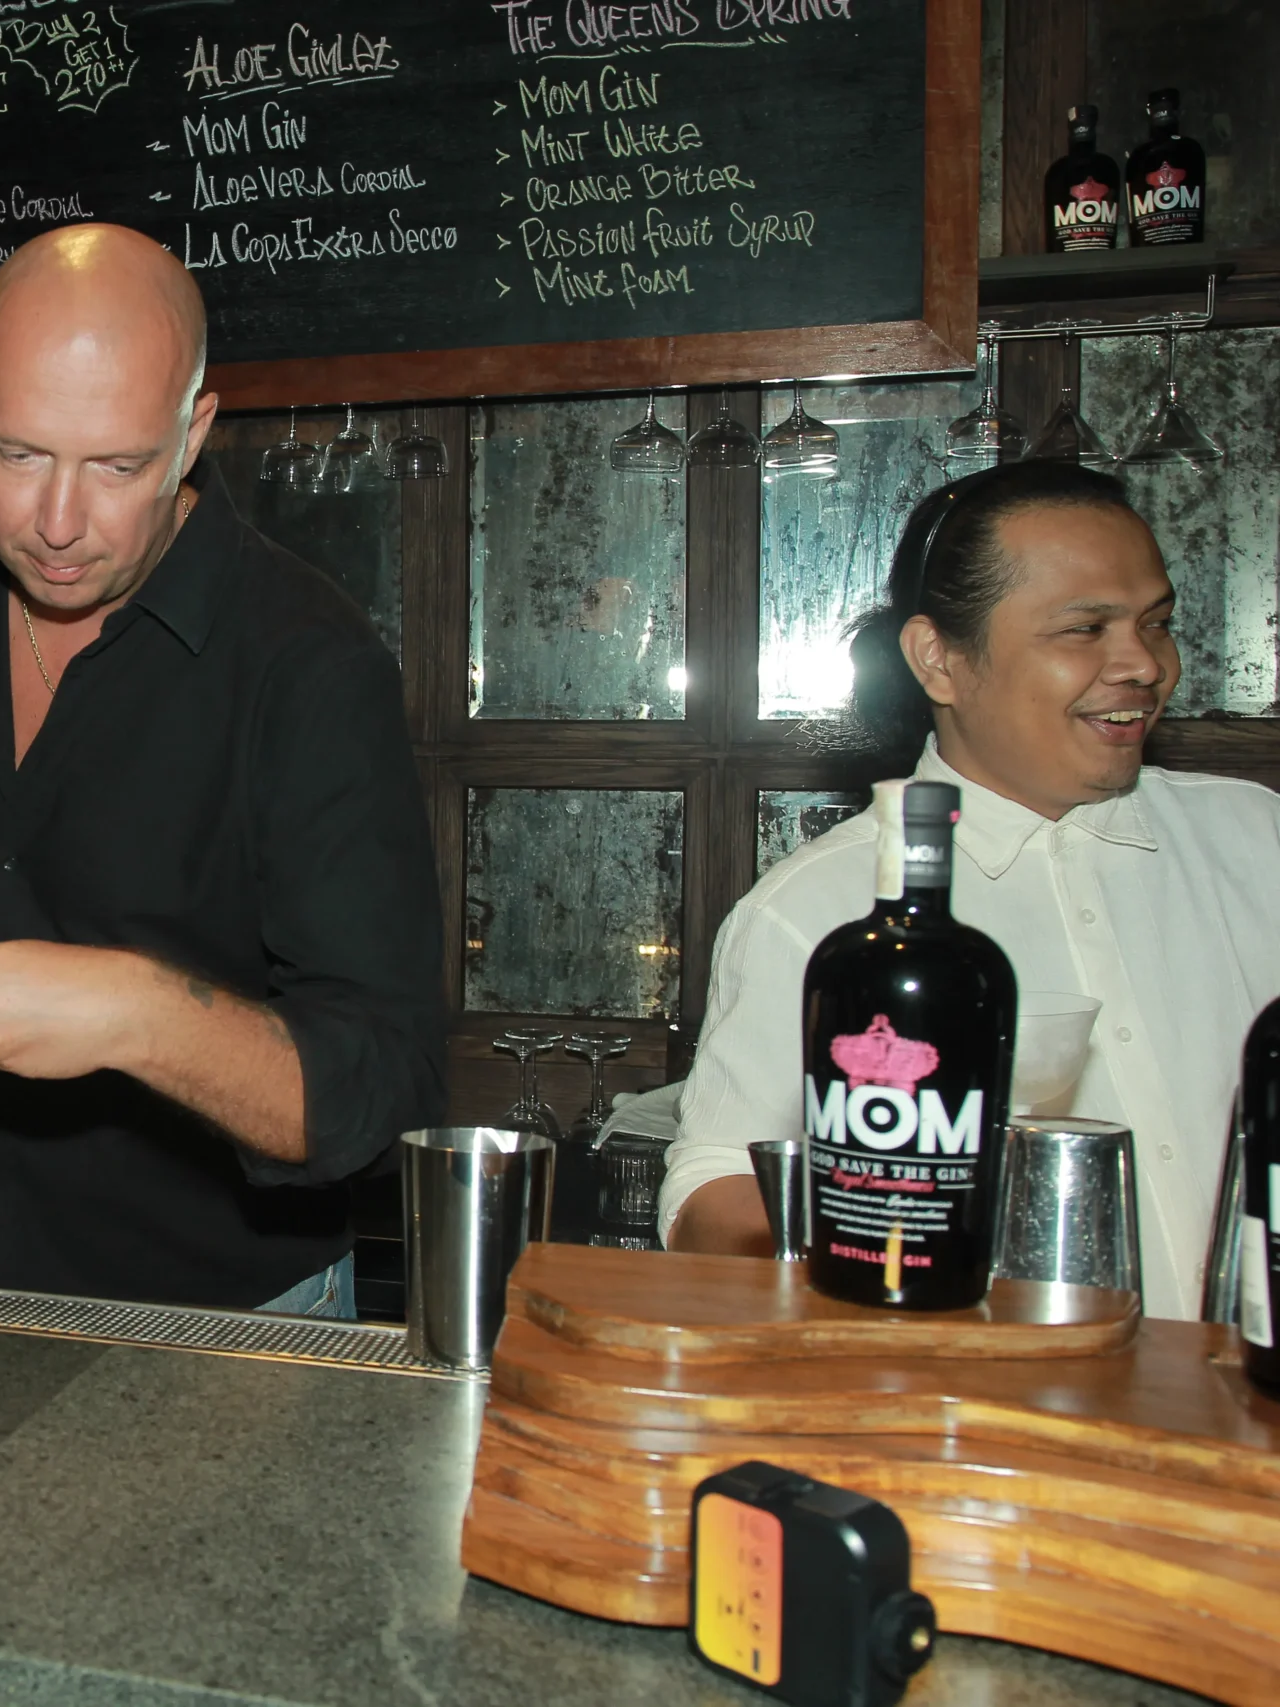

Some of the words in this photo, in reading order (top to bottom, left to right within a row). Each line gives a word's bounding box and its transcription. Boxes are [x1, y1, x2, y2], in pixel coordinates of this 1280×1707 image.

[82, 11, 101, 35] 2
[491, 0, 556, 55] THE
[64, 40, 98, 66] GET
[183, 36, 282, 91] ALOE
[1054, 200, 1117, 227] MOM
[1133, 185, 1200, 217] MOM
[805, 1073, 984, 1154] MOM
[839, 1157, 884, 1177] SAVE
[890, 1164, 931, 1181] THE
[903, 1254, 932, 1267] GIN
